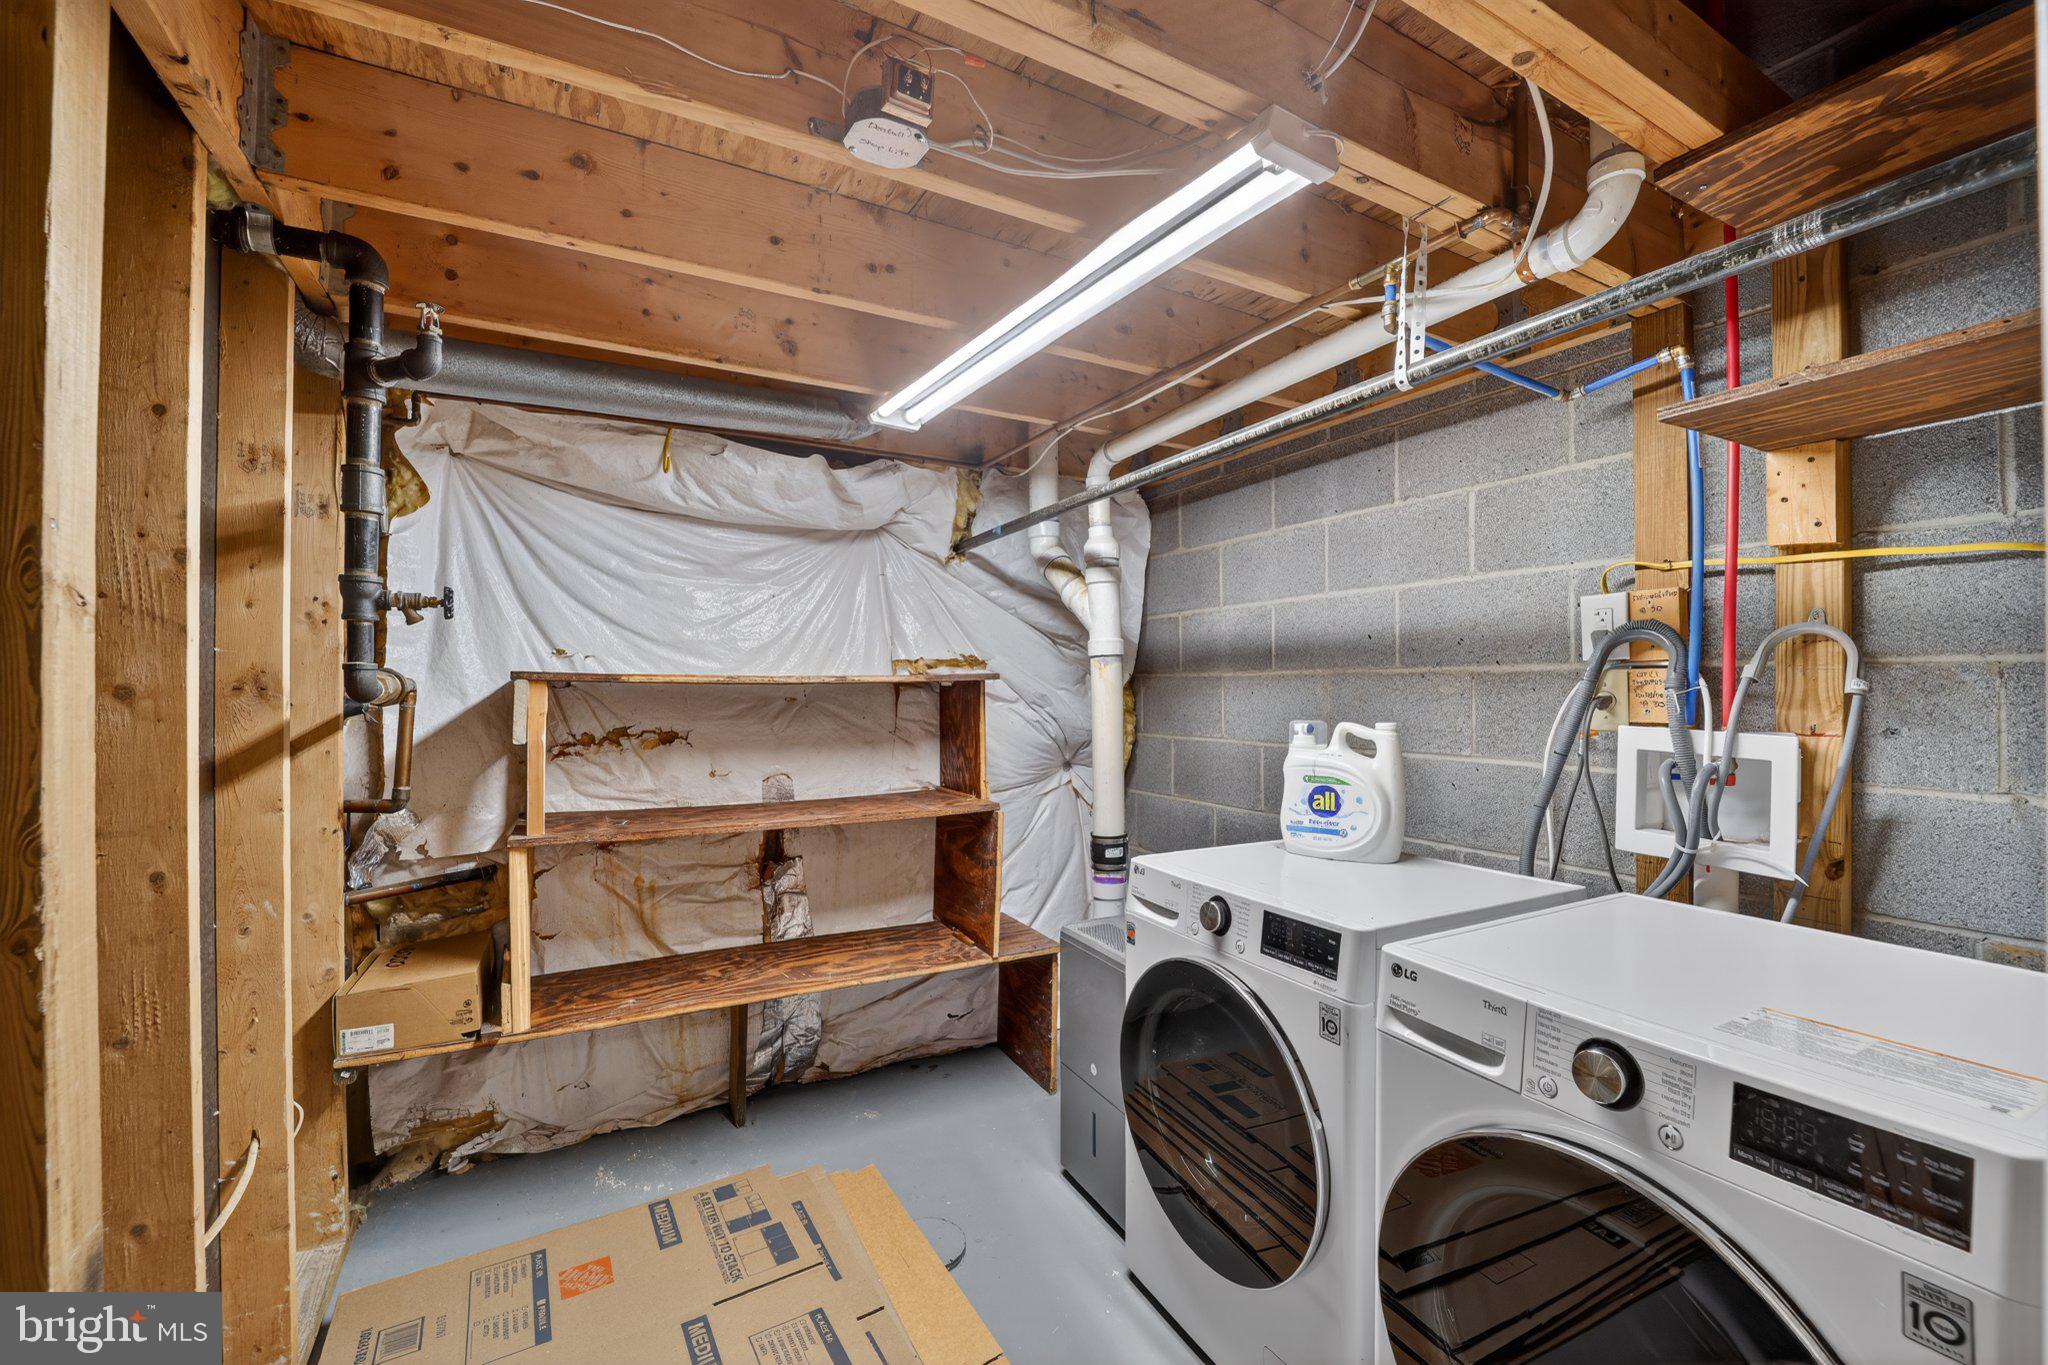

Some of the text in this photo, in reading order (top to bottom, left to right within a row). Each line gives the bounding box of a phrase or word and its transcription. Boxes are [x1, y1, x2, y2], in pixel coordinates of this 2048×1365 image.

[1312, 791, 1336, 811] all
[1404, 968, 1418, 982] LG
[653, 1203, 677, 1245] MEDIUM
[1909, 1301, 1966, 1346] 10
